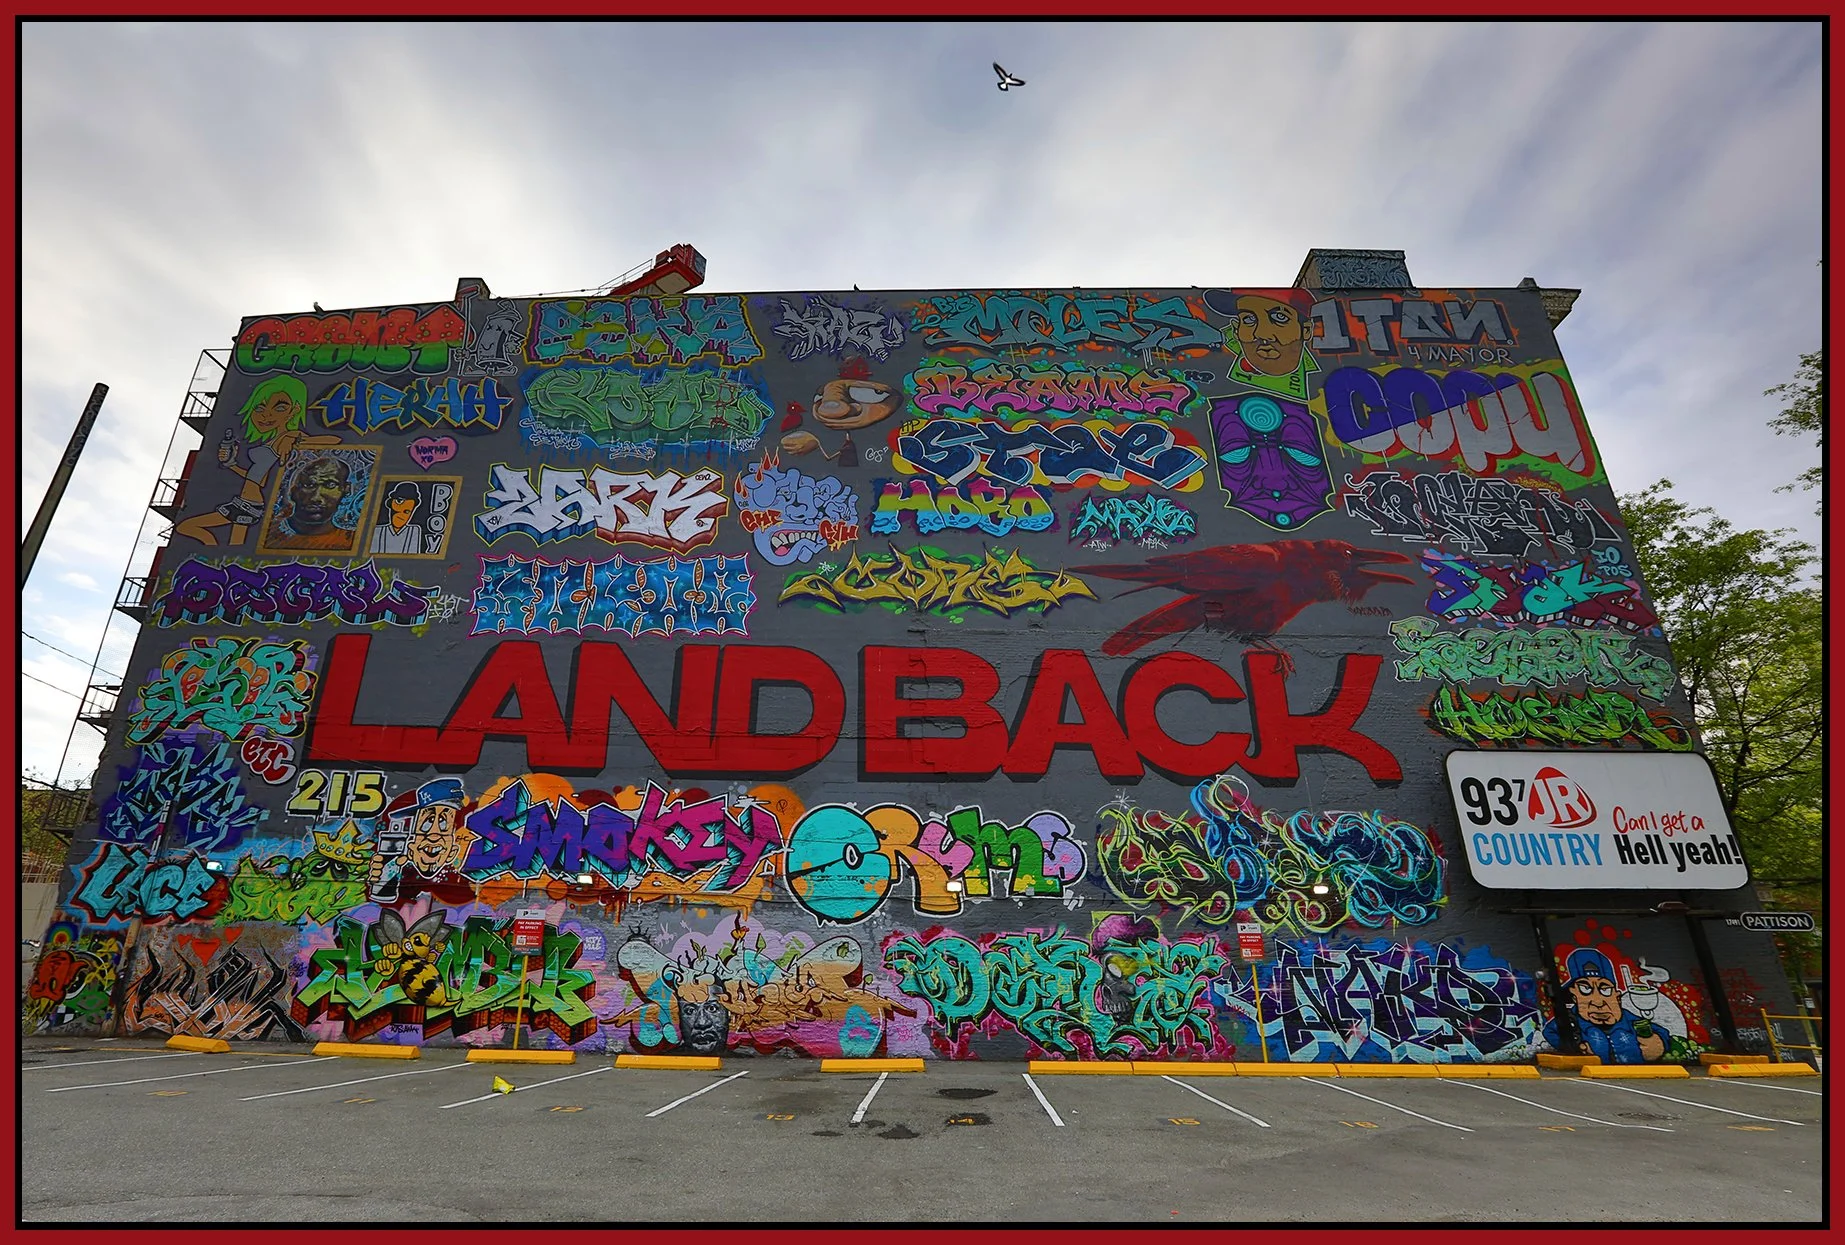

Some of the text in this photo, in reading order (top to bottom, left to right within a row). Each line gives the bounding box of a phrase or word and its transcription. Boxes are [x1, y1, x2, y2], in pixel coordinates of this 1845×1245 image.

[1408, 346, 1513, 364] 4 MAYOR
[304, 632, 847, 779] LAND
[858, 645, 1404, 787] BACK
[286, 769, 387, 819] 215
[1612, 806, 1649, 834] Can
[1661, 810, 1689, 837] get
[1691, 818, 1705, 832] a
[1472, 832, 1603, 866] COUNTRY
[1612, 834, 1743, 873] Hell yeah!
[1745, 915, 1811, 928] PATTISON
